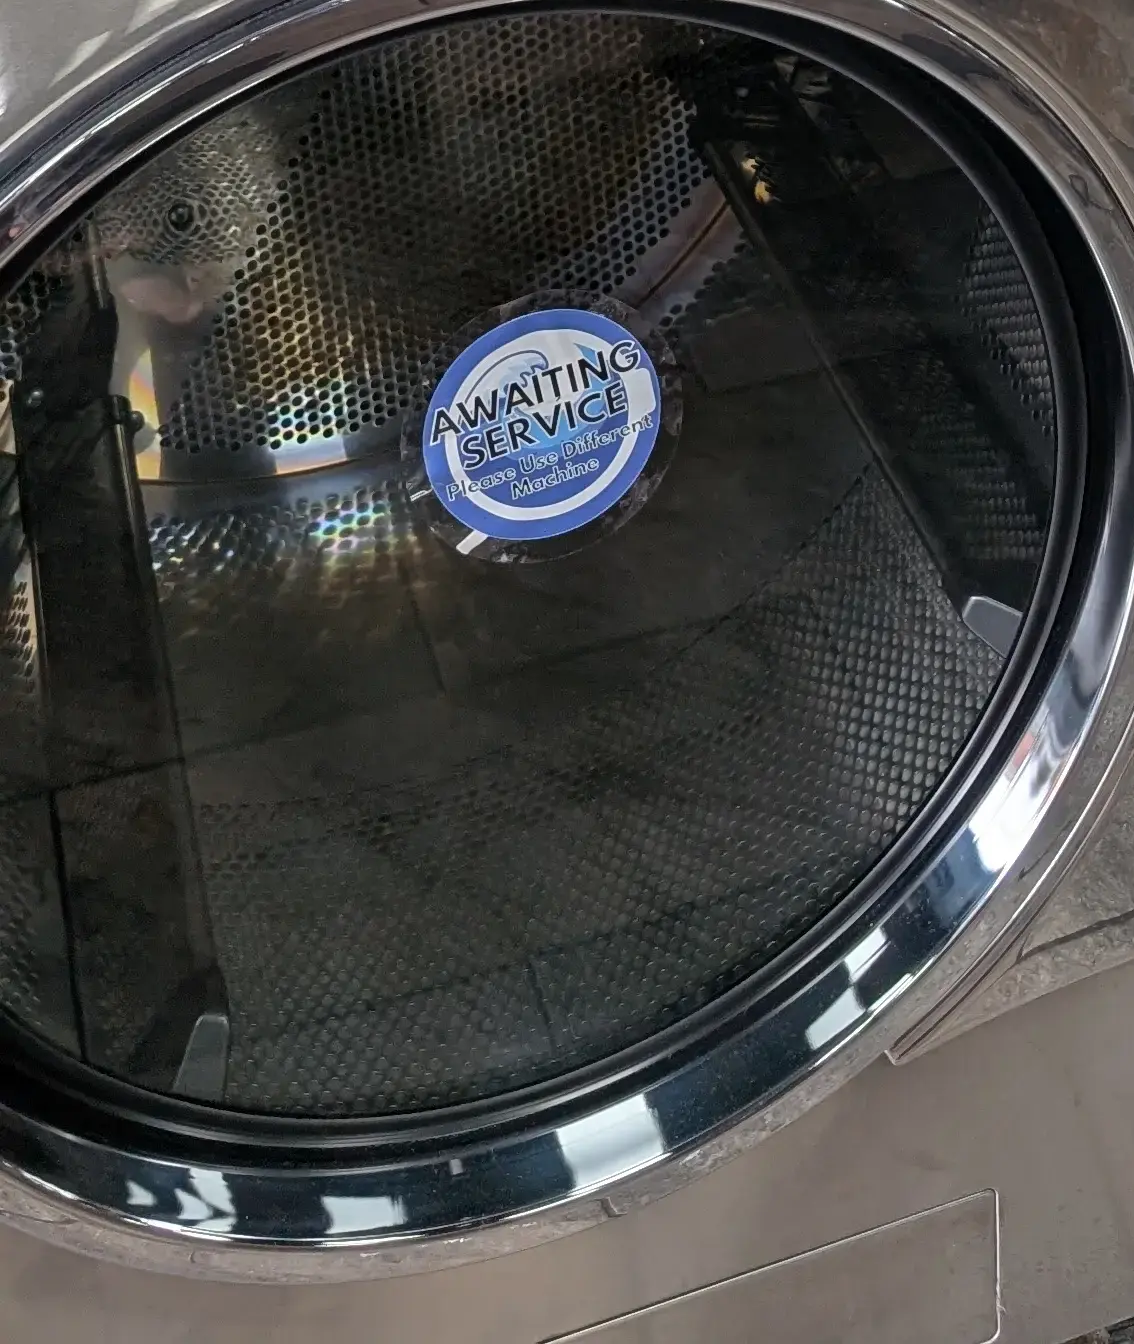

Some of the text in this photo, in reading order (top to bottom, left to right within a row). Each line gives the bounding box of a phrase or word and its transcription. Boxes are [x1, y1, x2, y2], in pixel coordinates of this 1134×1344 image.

[430, 340, 640, 446] AWAITING
[460, 383, 628, 470] SERVICE
[446, 413, 653, 502] Please Use Different
[511, 457, 600, 500] Machine
